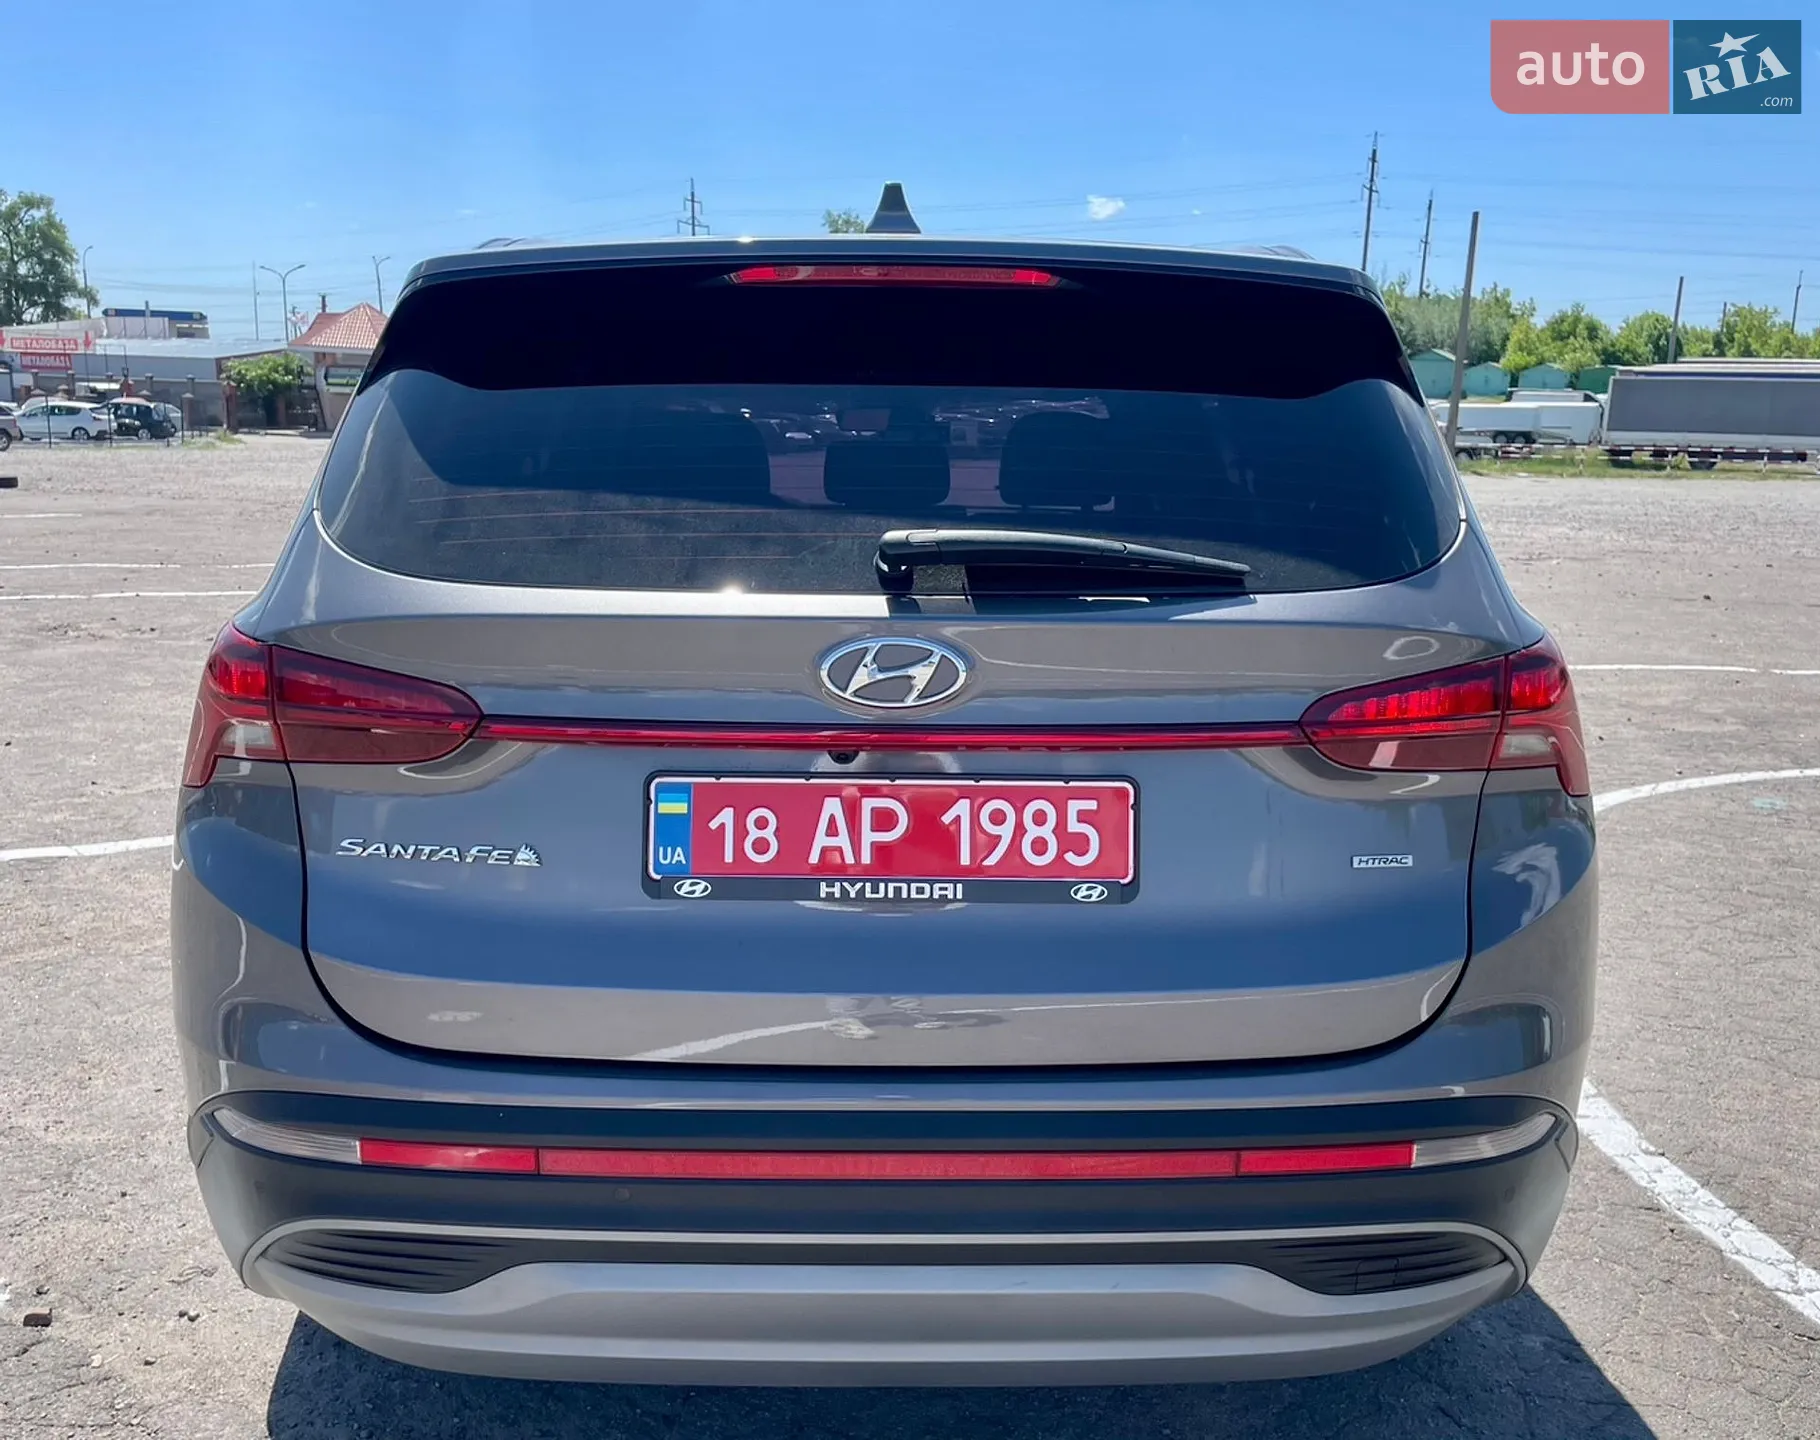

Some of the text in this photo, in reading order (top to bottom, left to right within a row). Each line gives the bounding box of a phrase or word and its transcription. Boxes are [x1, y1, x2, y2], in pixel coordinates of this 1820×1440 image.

[707, 806, 779, 863] 18
[940, 798, 1100, 866] 1985
[336, 838, 513, 865] SANTA FE
[658, 846, 686, 864] UA
[1358, 856, 1409, 866] HTRAC
[819, 881, 963, 899] HYUNDAI
